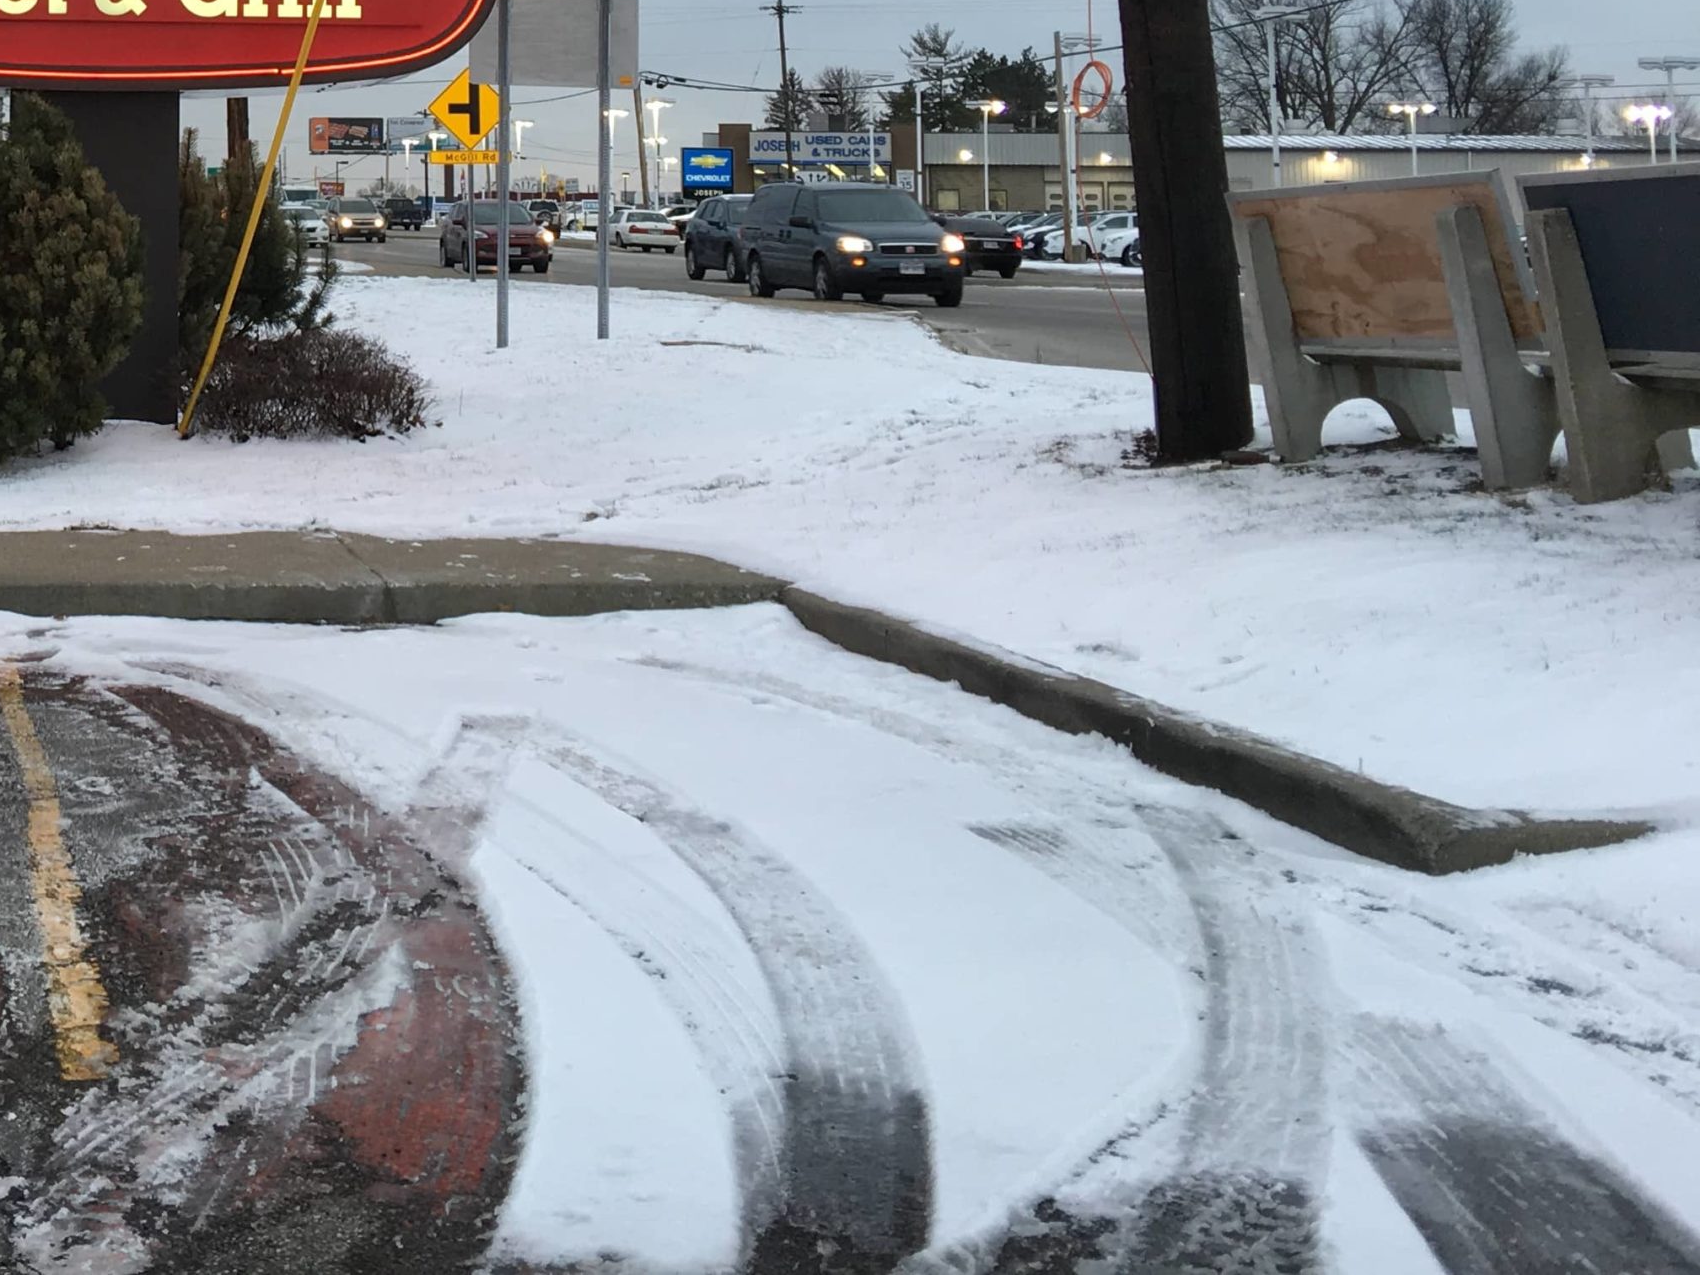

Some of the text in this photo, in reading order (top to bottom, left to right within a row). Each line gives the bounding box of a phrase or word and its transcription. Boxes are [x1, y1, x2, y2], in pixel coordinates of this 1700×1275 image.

[804, 136, 843, 145] USED
[753, 140, 800, 152] JOSEH
[811, 148, 821, 157] &
[445, 153, 496, 162] McGill Rd
[685, 174, 731, 183] CHEVROLET
